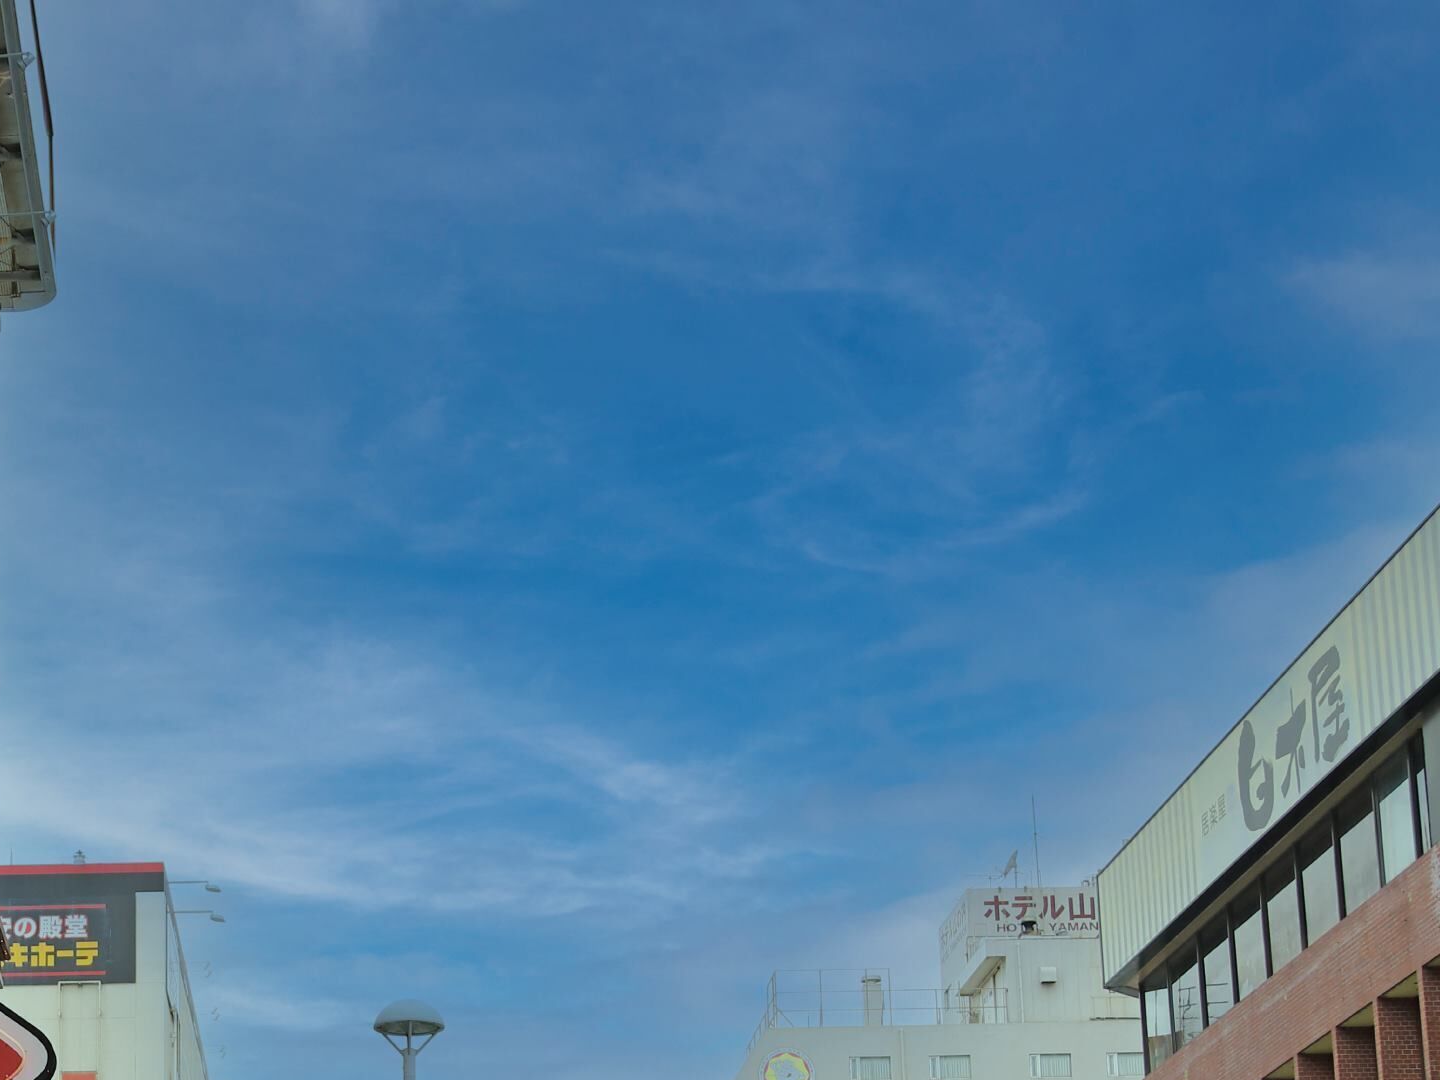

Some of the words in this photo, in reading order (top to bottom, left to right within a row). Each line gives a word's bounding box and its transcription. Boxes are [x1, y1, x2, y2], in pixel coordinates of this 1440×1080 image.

[1237, 645, 1351, 832] 白木屋
[983, 893, 1096, 921] ホテル山
